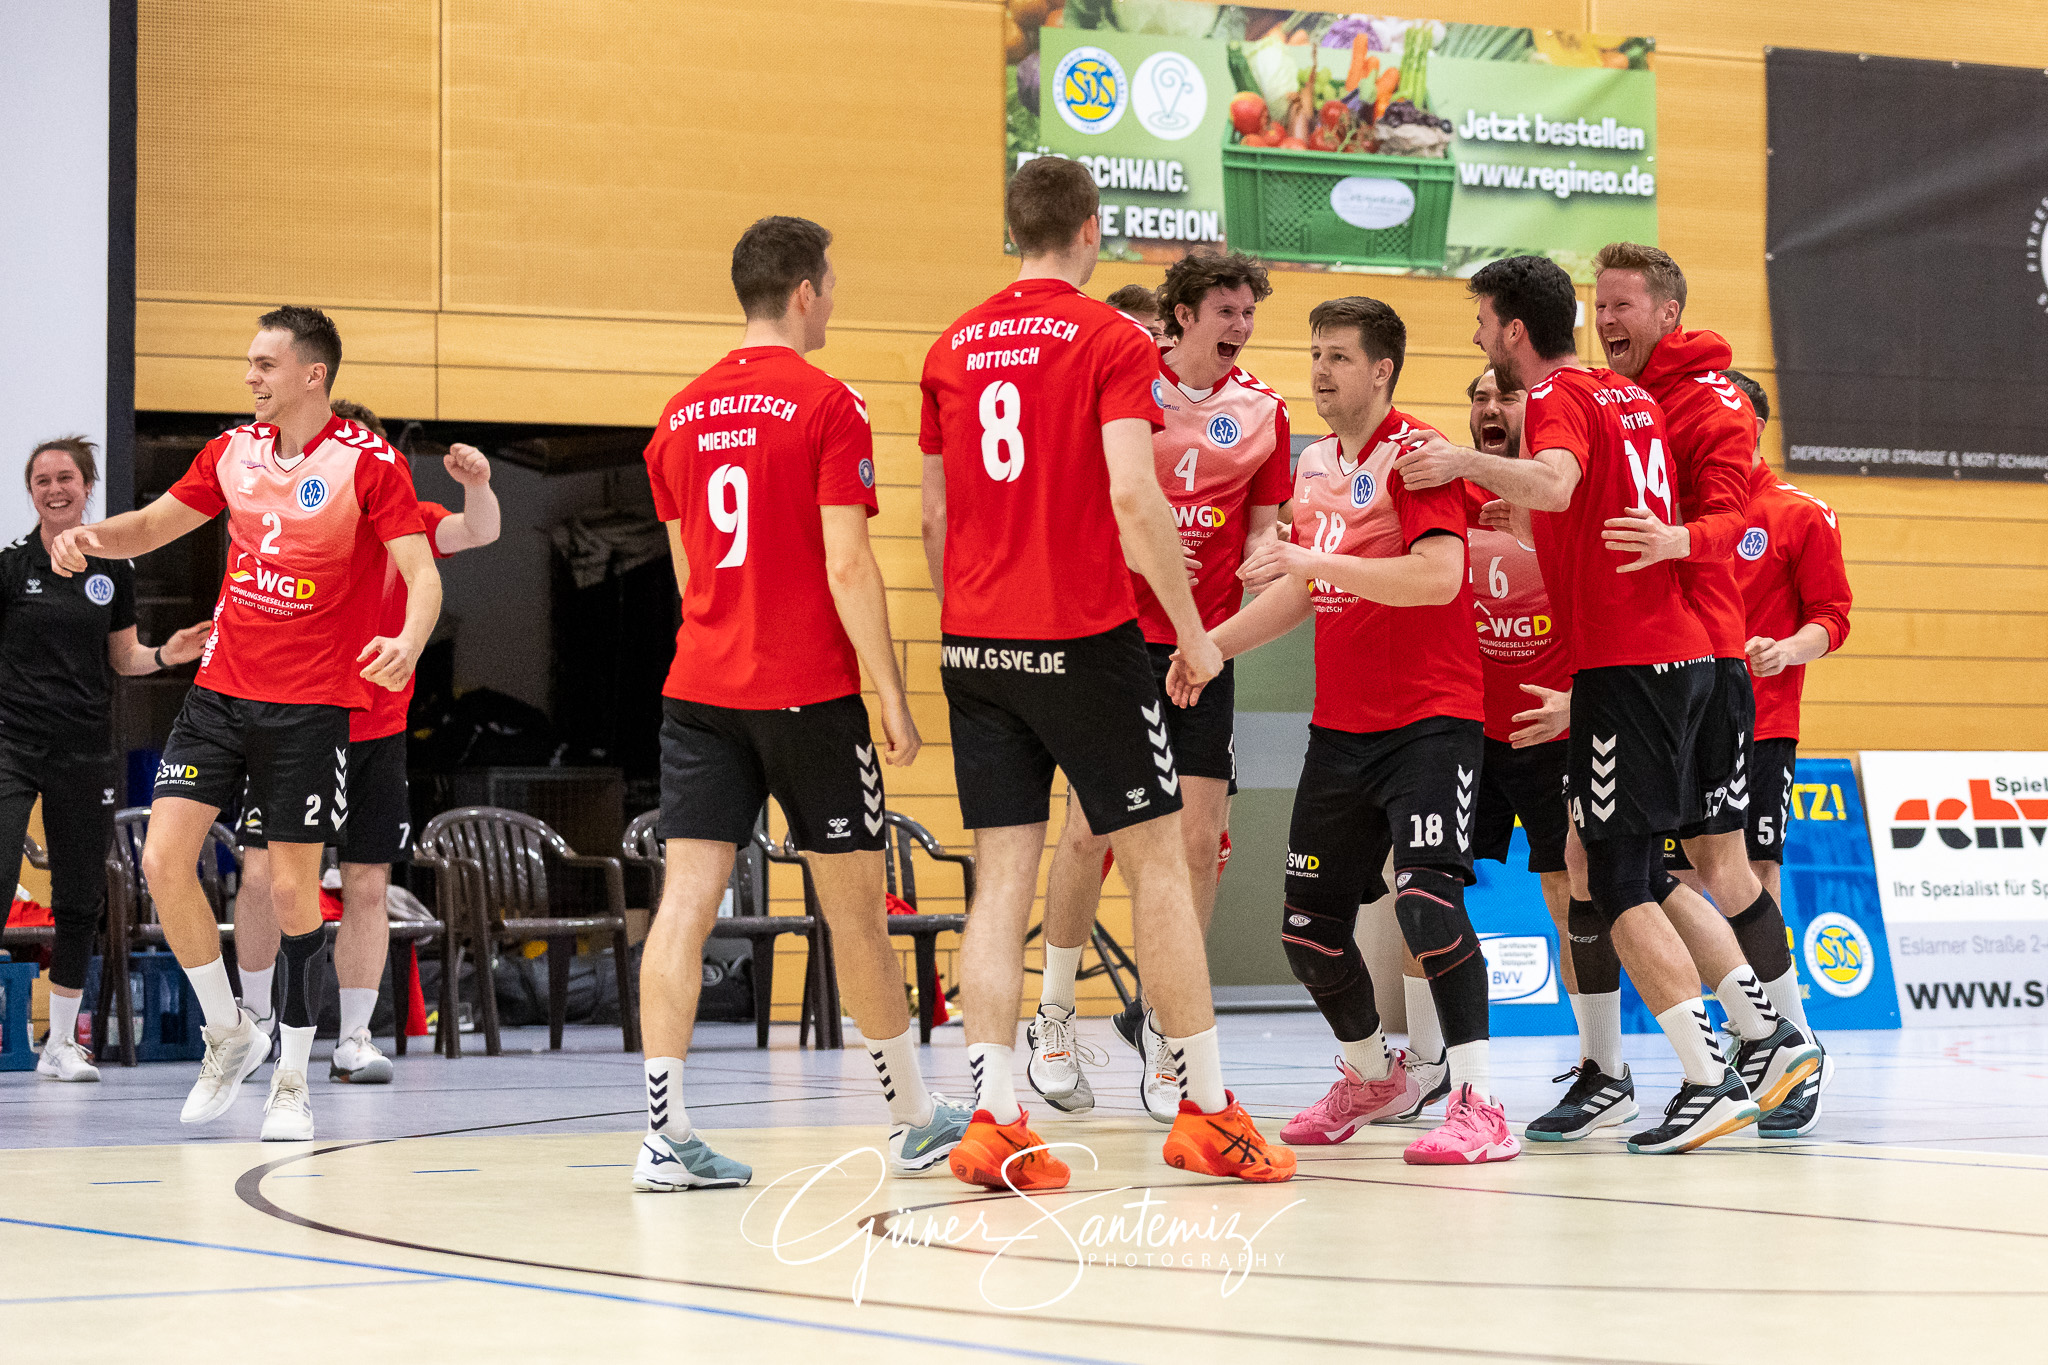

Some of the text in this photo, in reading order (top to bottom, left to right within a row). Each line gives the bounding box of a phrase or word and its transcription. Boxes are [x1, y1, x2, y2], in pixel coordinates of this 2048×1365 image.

[1459, 109, 1645, 149] Jetzt bestellen
[1459, 160, 1655, 198] www.regineo.de
[1124, 205, 1225, 242] REGION.
[951, 317, 1079, 350] GSVE DELITZSCH
[966, 347, 1040, 371] ROTTOSCH
[670, 394, 798, 431] GSVE DELITZSCH
[698, 428, 757, 452] MIERSCH
[979, 380, 1025, 483] 8
[1174, 448, 1199, 491] 4
[1624, 438, 1671, 524] 14
[707, 463, 749, 569] 9
[1171, 506, 1226, 528] WGD
[260, 511, 282, 555] 2
[1311, 511, 1347, 554] 18
[256, 565, 316, 600] WGD
[1488, 556, 1509, 599] 6
[229, 585, 314, 611] WOHNUNGSGESELLSCHAFT
[1489, 615, 1552, 638] WGD
[1498, 649, 1536, 657] DELITZSCH
[161, 764, 198, 779] SWD
[1995, 776, 2048, 795] Spiel
[304, 794, 322, 826] 2
[399, 822, 411, 849] 7
[1409, 813, 1444, 848] 18
[1757, 816, 1774, 846] 5
[1288, 852, 1320, 870] SWD
[1893, 881, 1915, 897] Ihr
[1921, 880, 2000, 901] Spezialist
[2004, 879, 2026, 896] für
[1900, 936, 1967, 956] Eslarner
[1972, 935, 2026, 955] Straße
[1492, 971, 1523, 984] BVV
